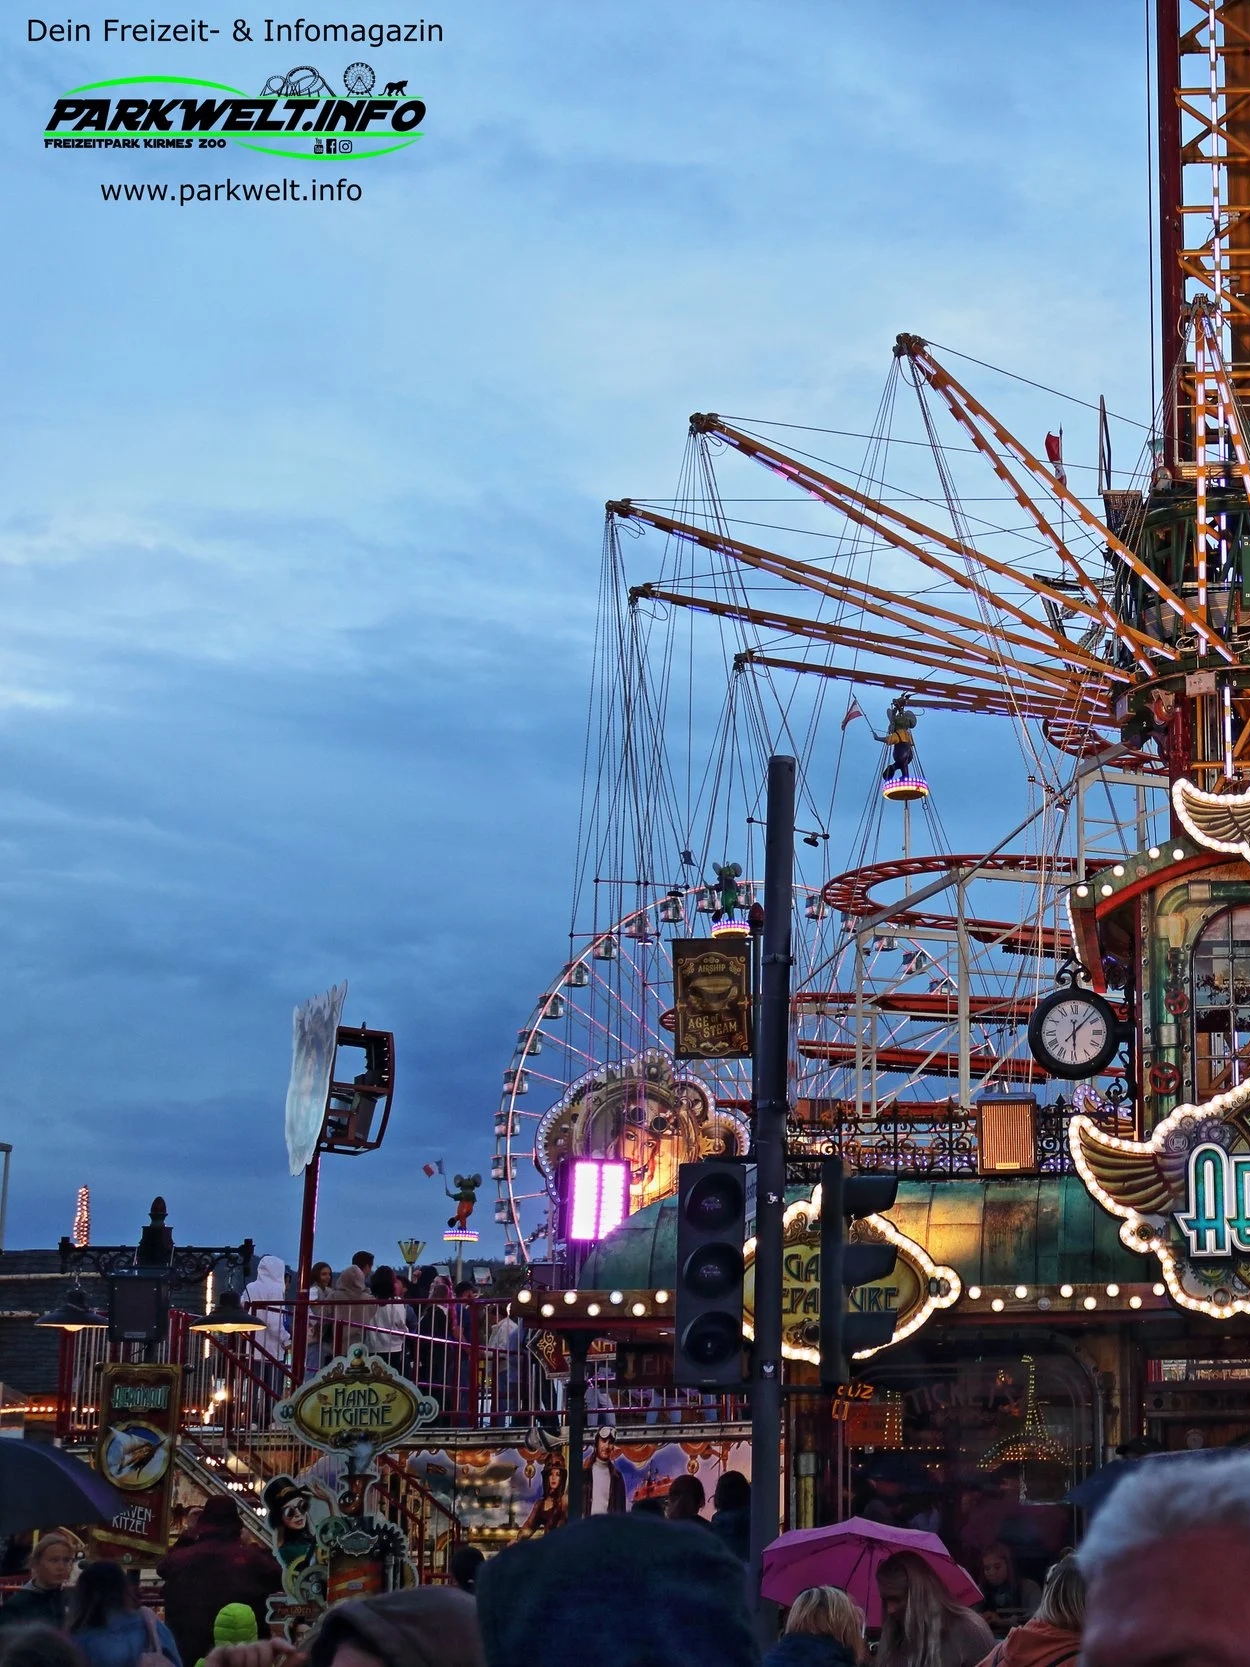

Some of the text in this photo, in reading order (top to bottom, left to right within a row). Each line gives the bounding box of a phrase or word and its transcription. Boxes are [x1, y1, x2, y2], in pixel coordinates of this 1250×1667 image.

[688, 1016, 709, 1029] AGE
[703, 1021, 737, 1038] STEAM
[333, 1387, 379, 1407] HAND
[321, 1405, 392, 1427] HYGIENE
[112, 1515, 148, 1536] KITZEL
